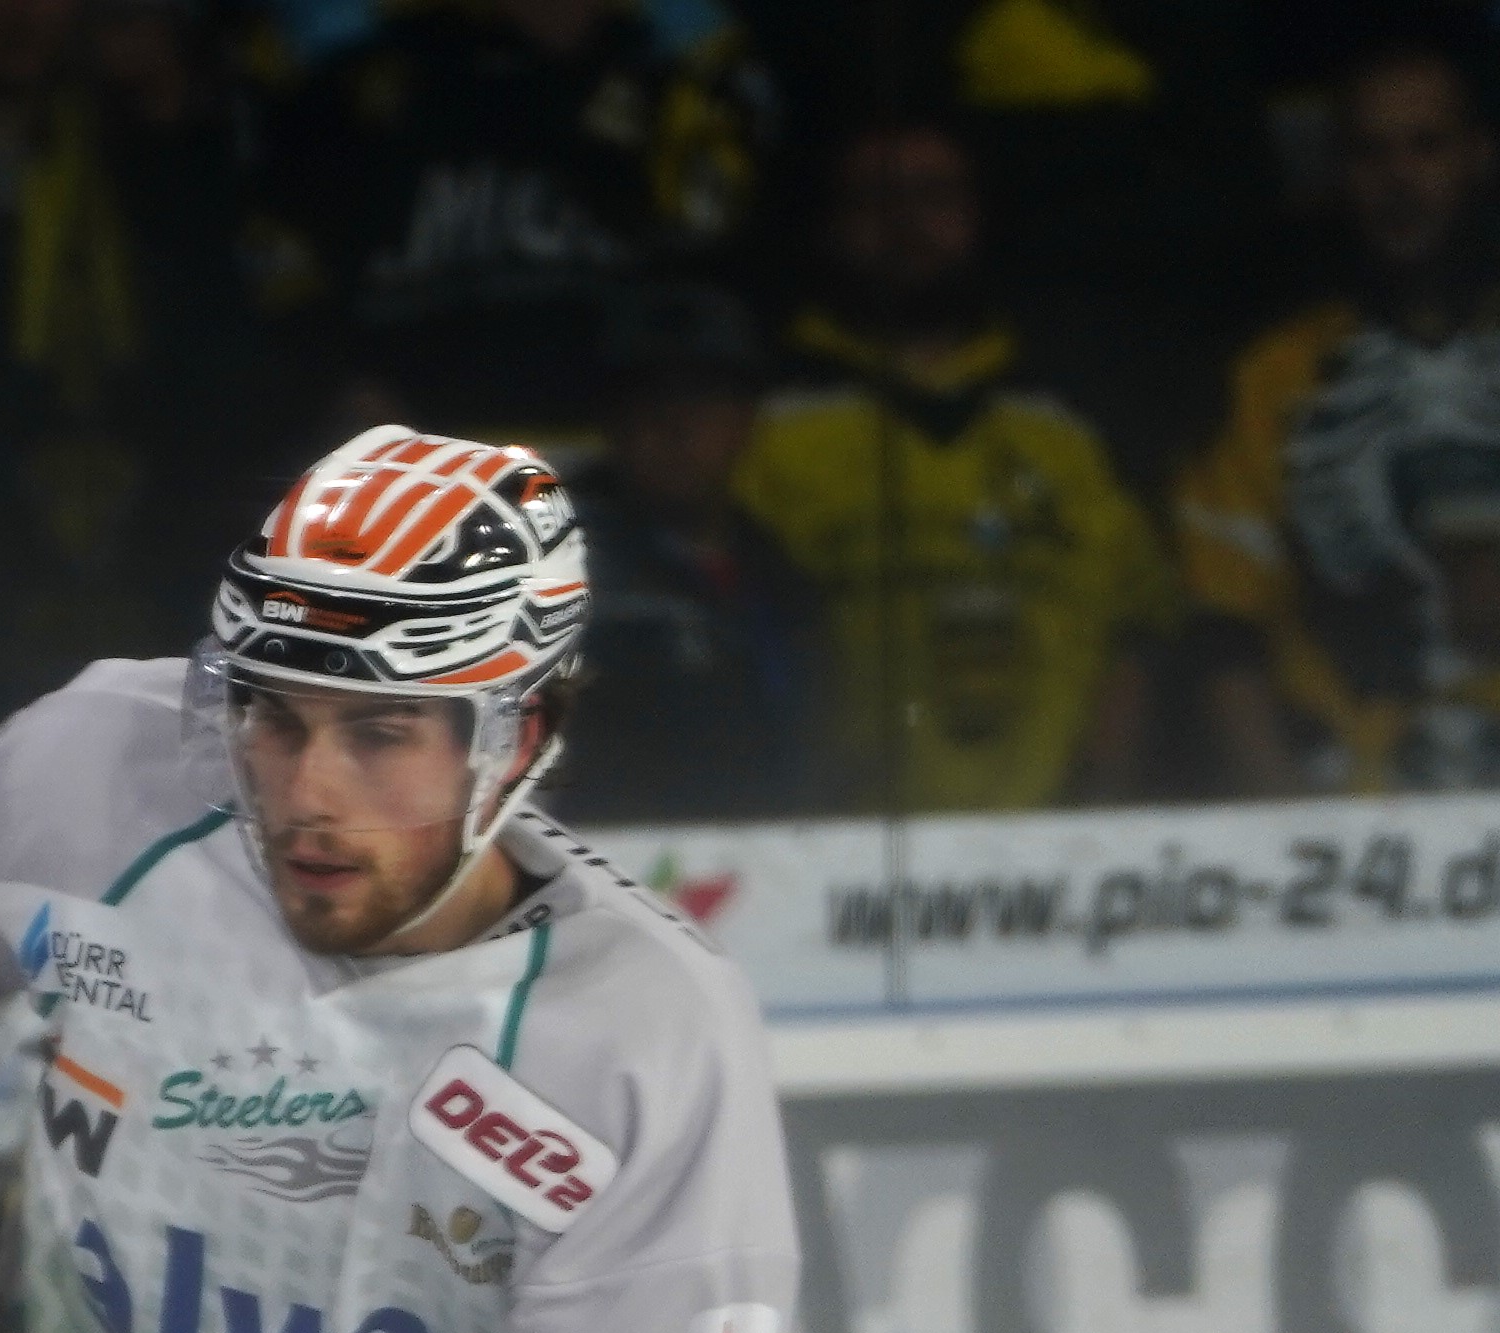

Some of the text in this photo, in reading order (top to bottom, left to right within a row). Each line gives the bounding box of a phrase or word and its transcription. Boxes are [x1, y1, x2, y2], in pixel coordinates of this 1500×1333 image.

[56, 960, 154, 1024] ENTAL
[152, 1068, 368, 1131] Steelers
[422, 1076, 596, 1214] DEL2
